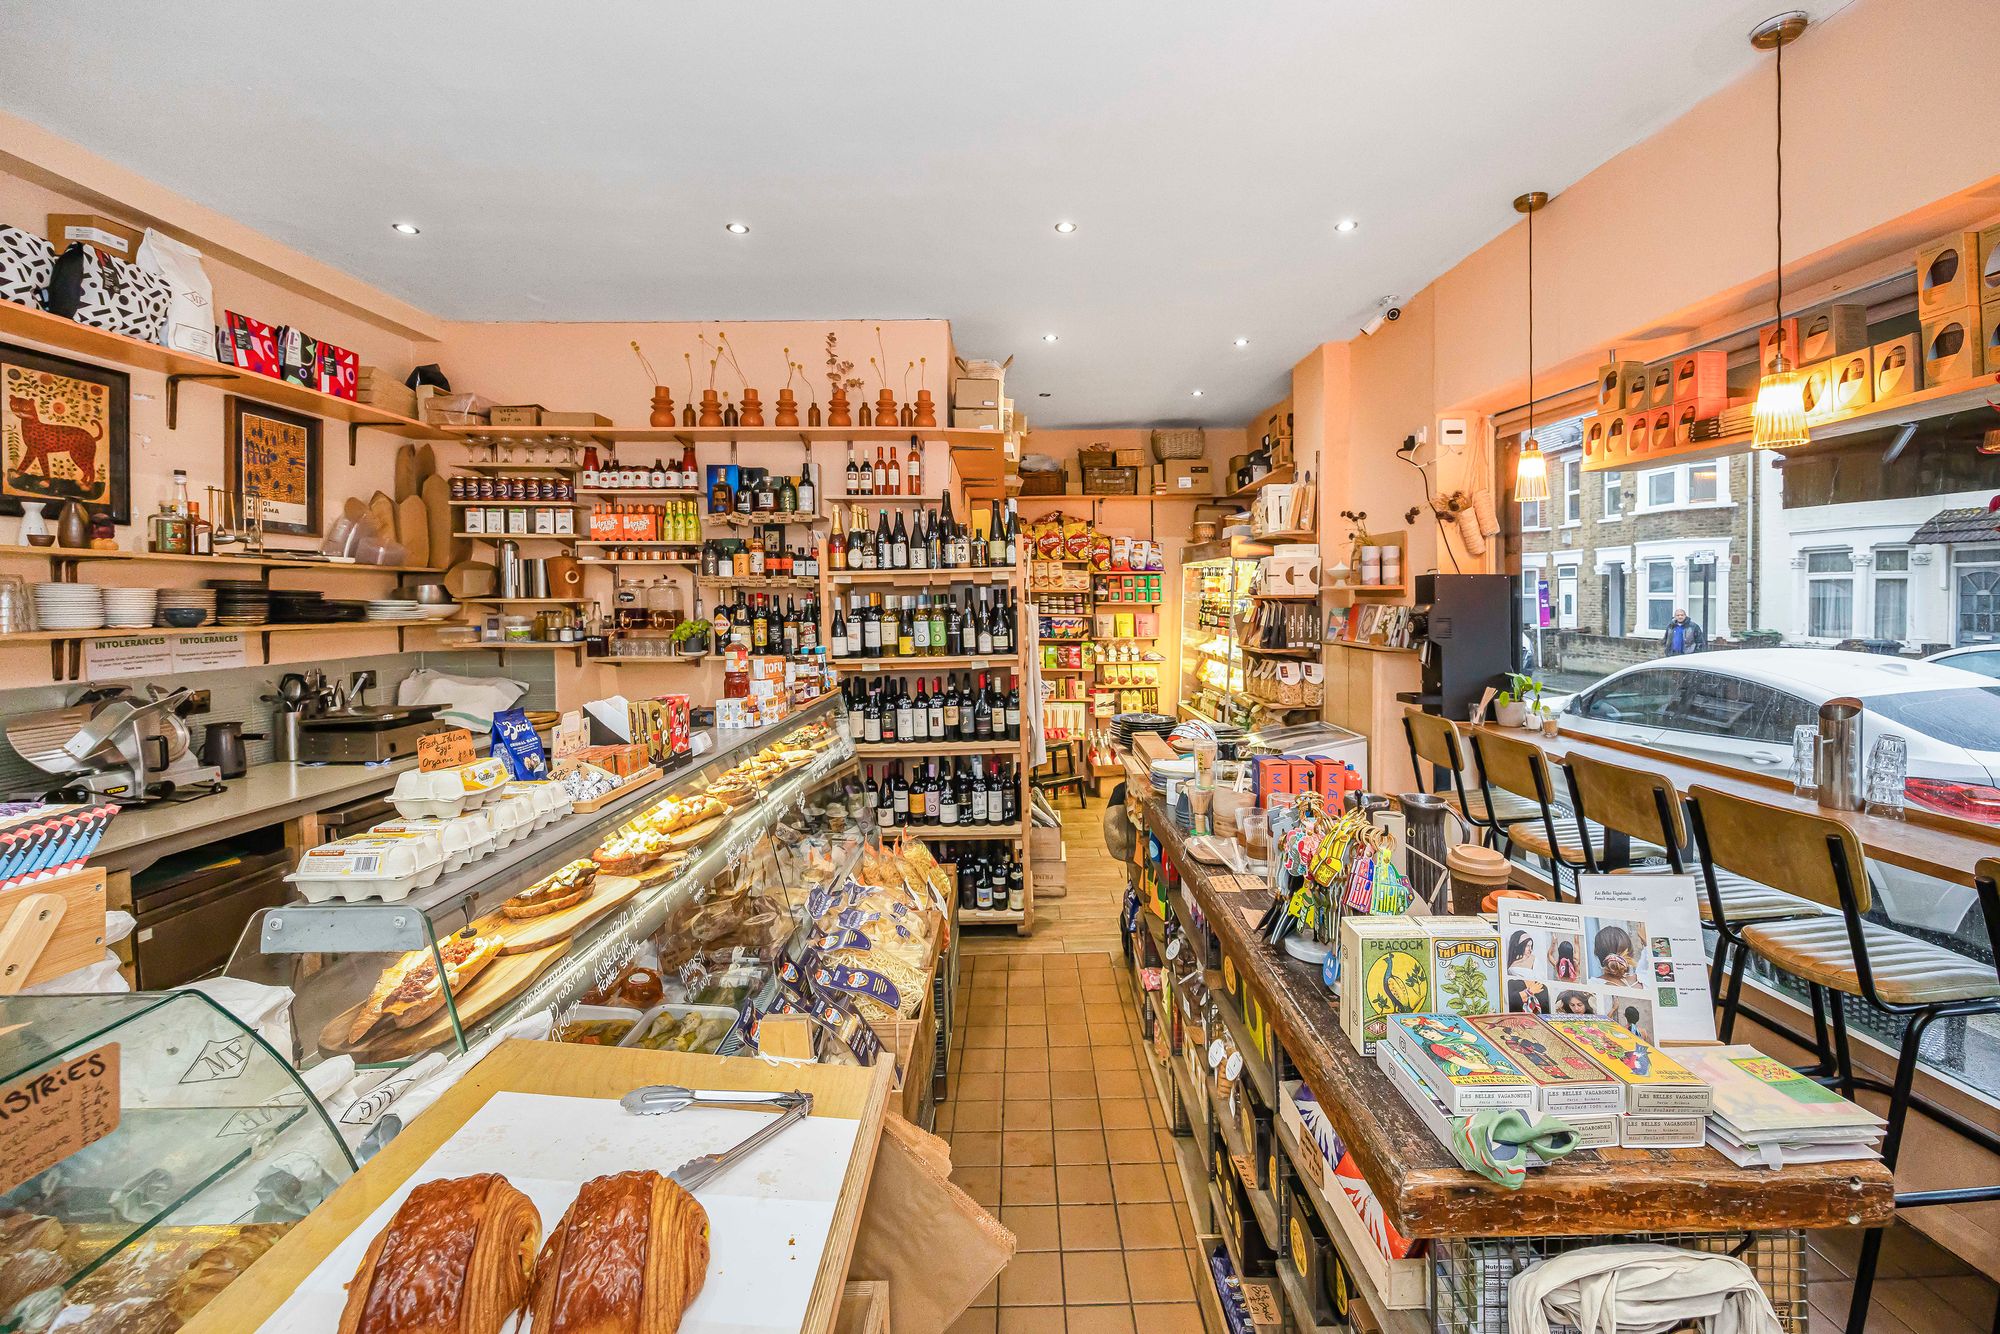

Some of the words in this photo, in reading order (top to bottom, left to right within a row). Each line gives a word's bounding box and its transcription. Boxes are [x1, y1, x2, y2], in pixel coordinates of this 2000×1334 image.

[95, 637, 165, 650] INTOLERANCES
[179, 635, 238, 645] INTOLERANCES
[764, 662, 783, 673] TOFU
[502, 721, 530, 740] Baci
[442, 733, 467, 744] Italian
[422, 758, 454, 768] Organic
[1328, 773, 1338, 814] MÆG
[1370, 940, 1424, 950] PEACOCK
[1439, 947, 1456, 958] THE
[1458, 943, 1495, 958] MELATTI
